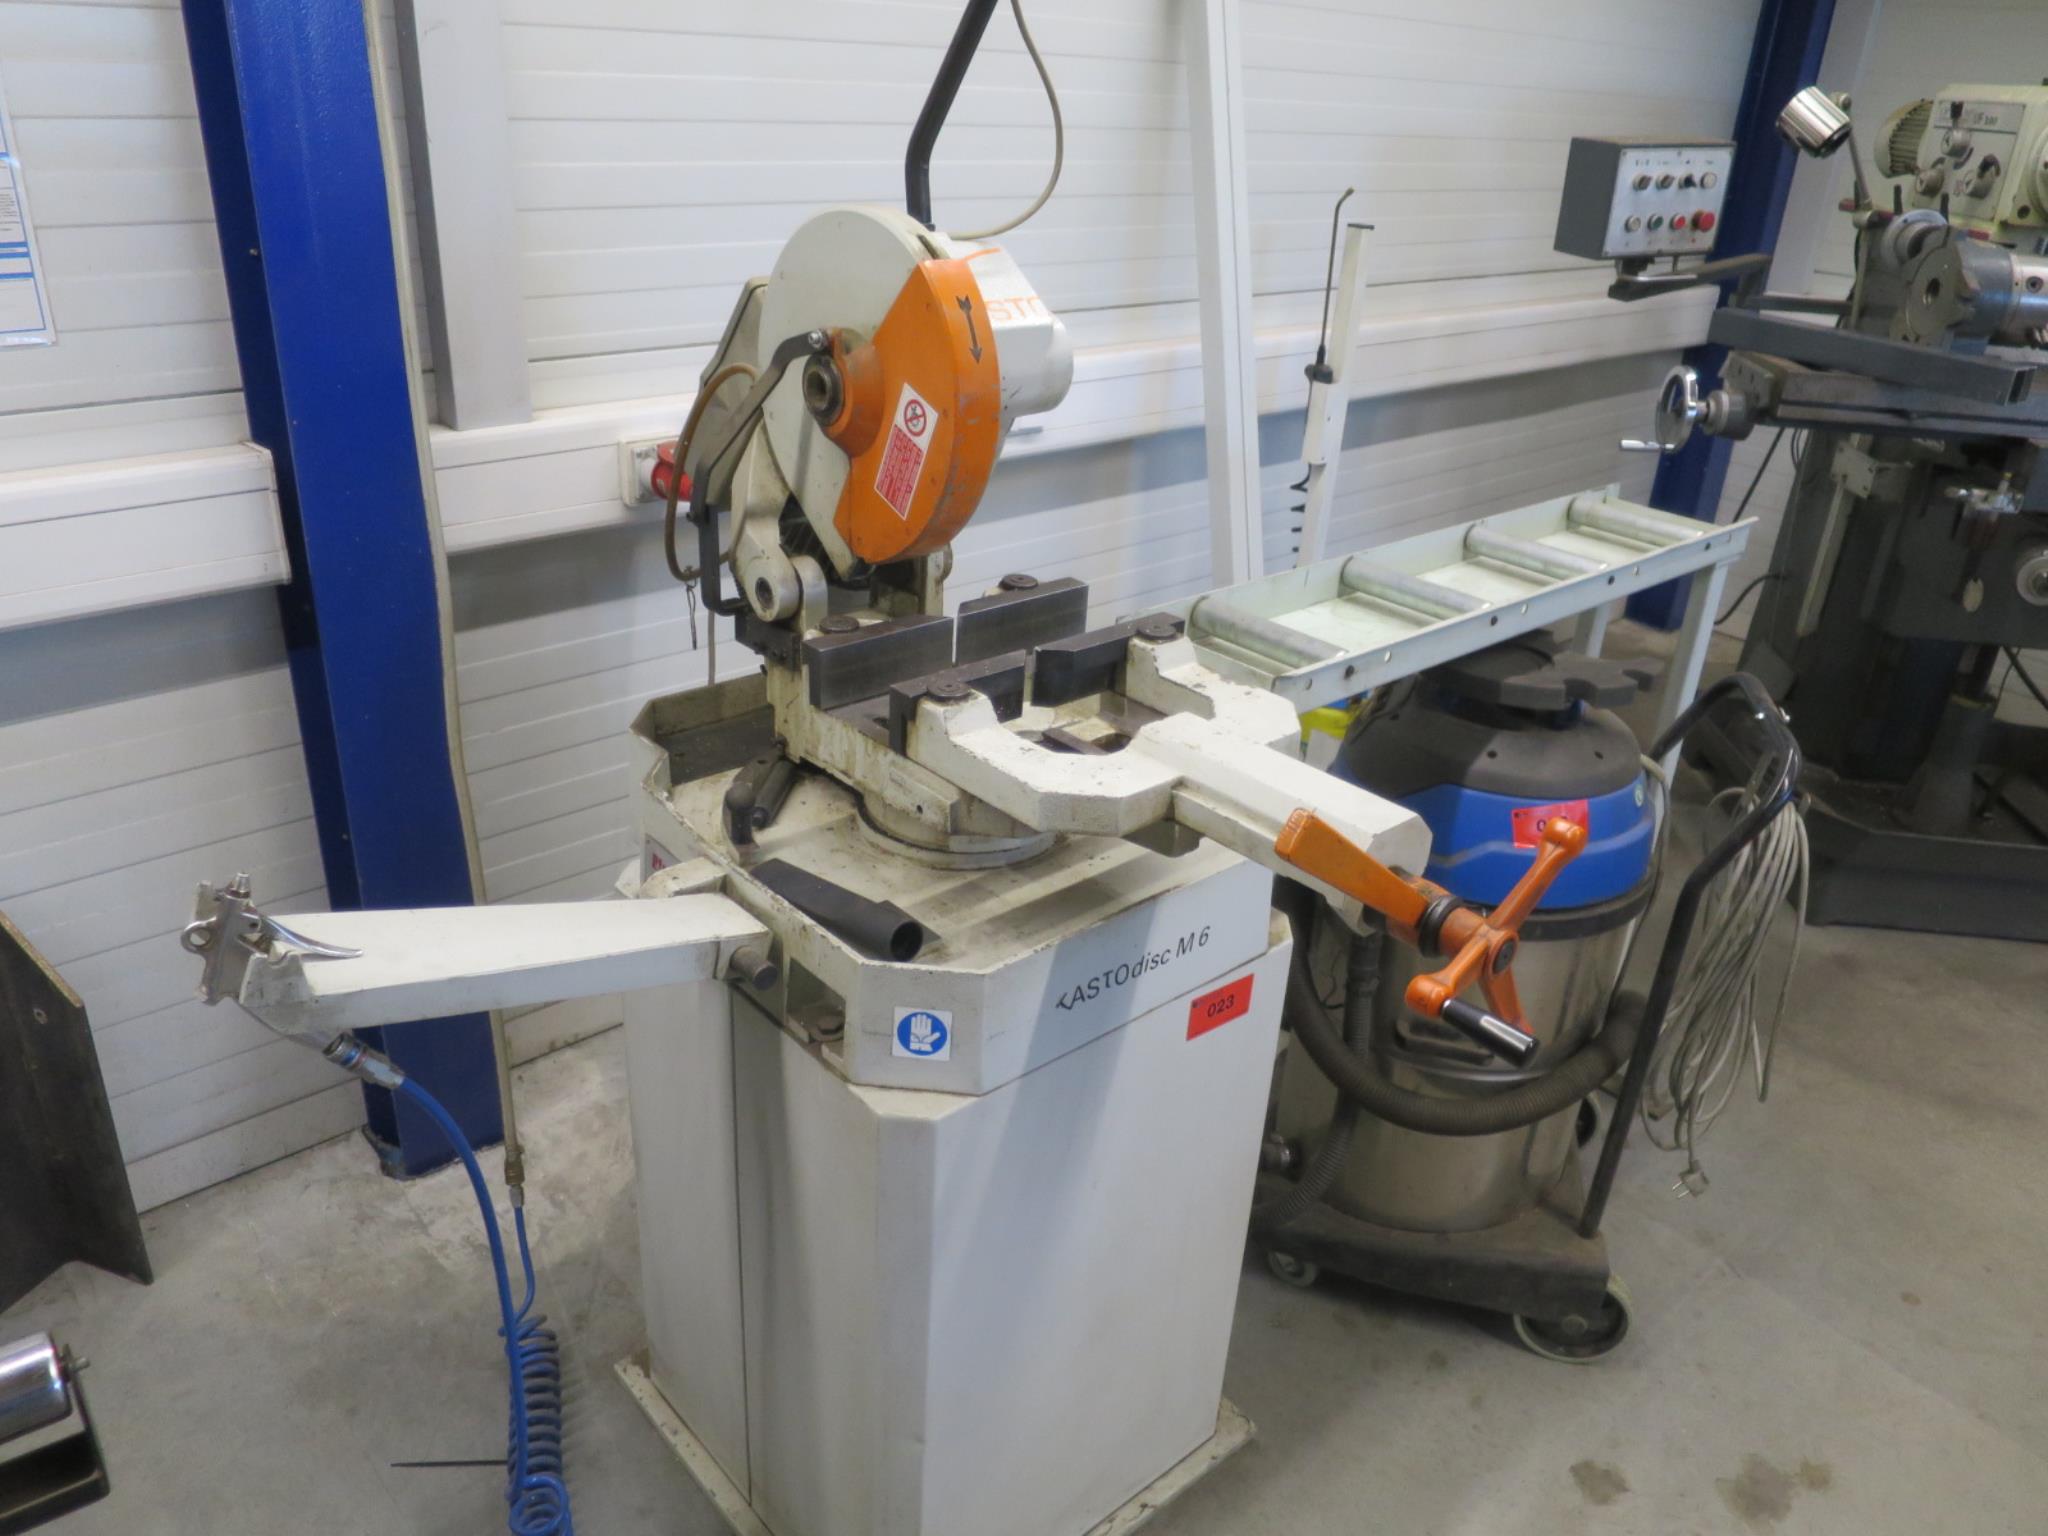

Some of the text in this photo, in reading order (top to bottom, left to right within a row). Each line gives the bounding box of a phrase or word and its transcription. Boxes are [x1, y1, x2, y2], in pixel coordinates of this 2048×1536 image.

[1176, 932, 1194, 959] M
[1199, 925, 1211, 947] 6
[1207, 994, 1235, 1018] 023
